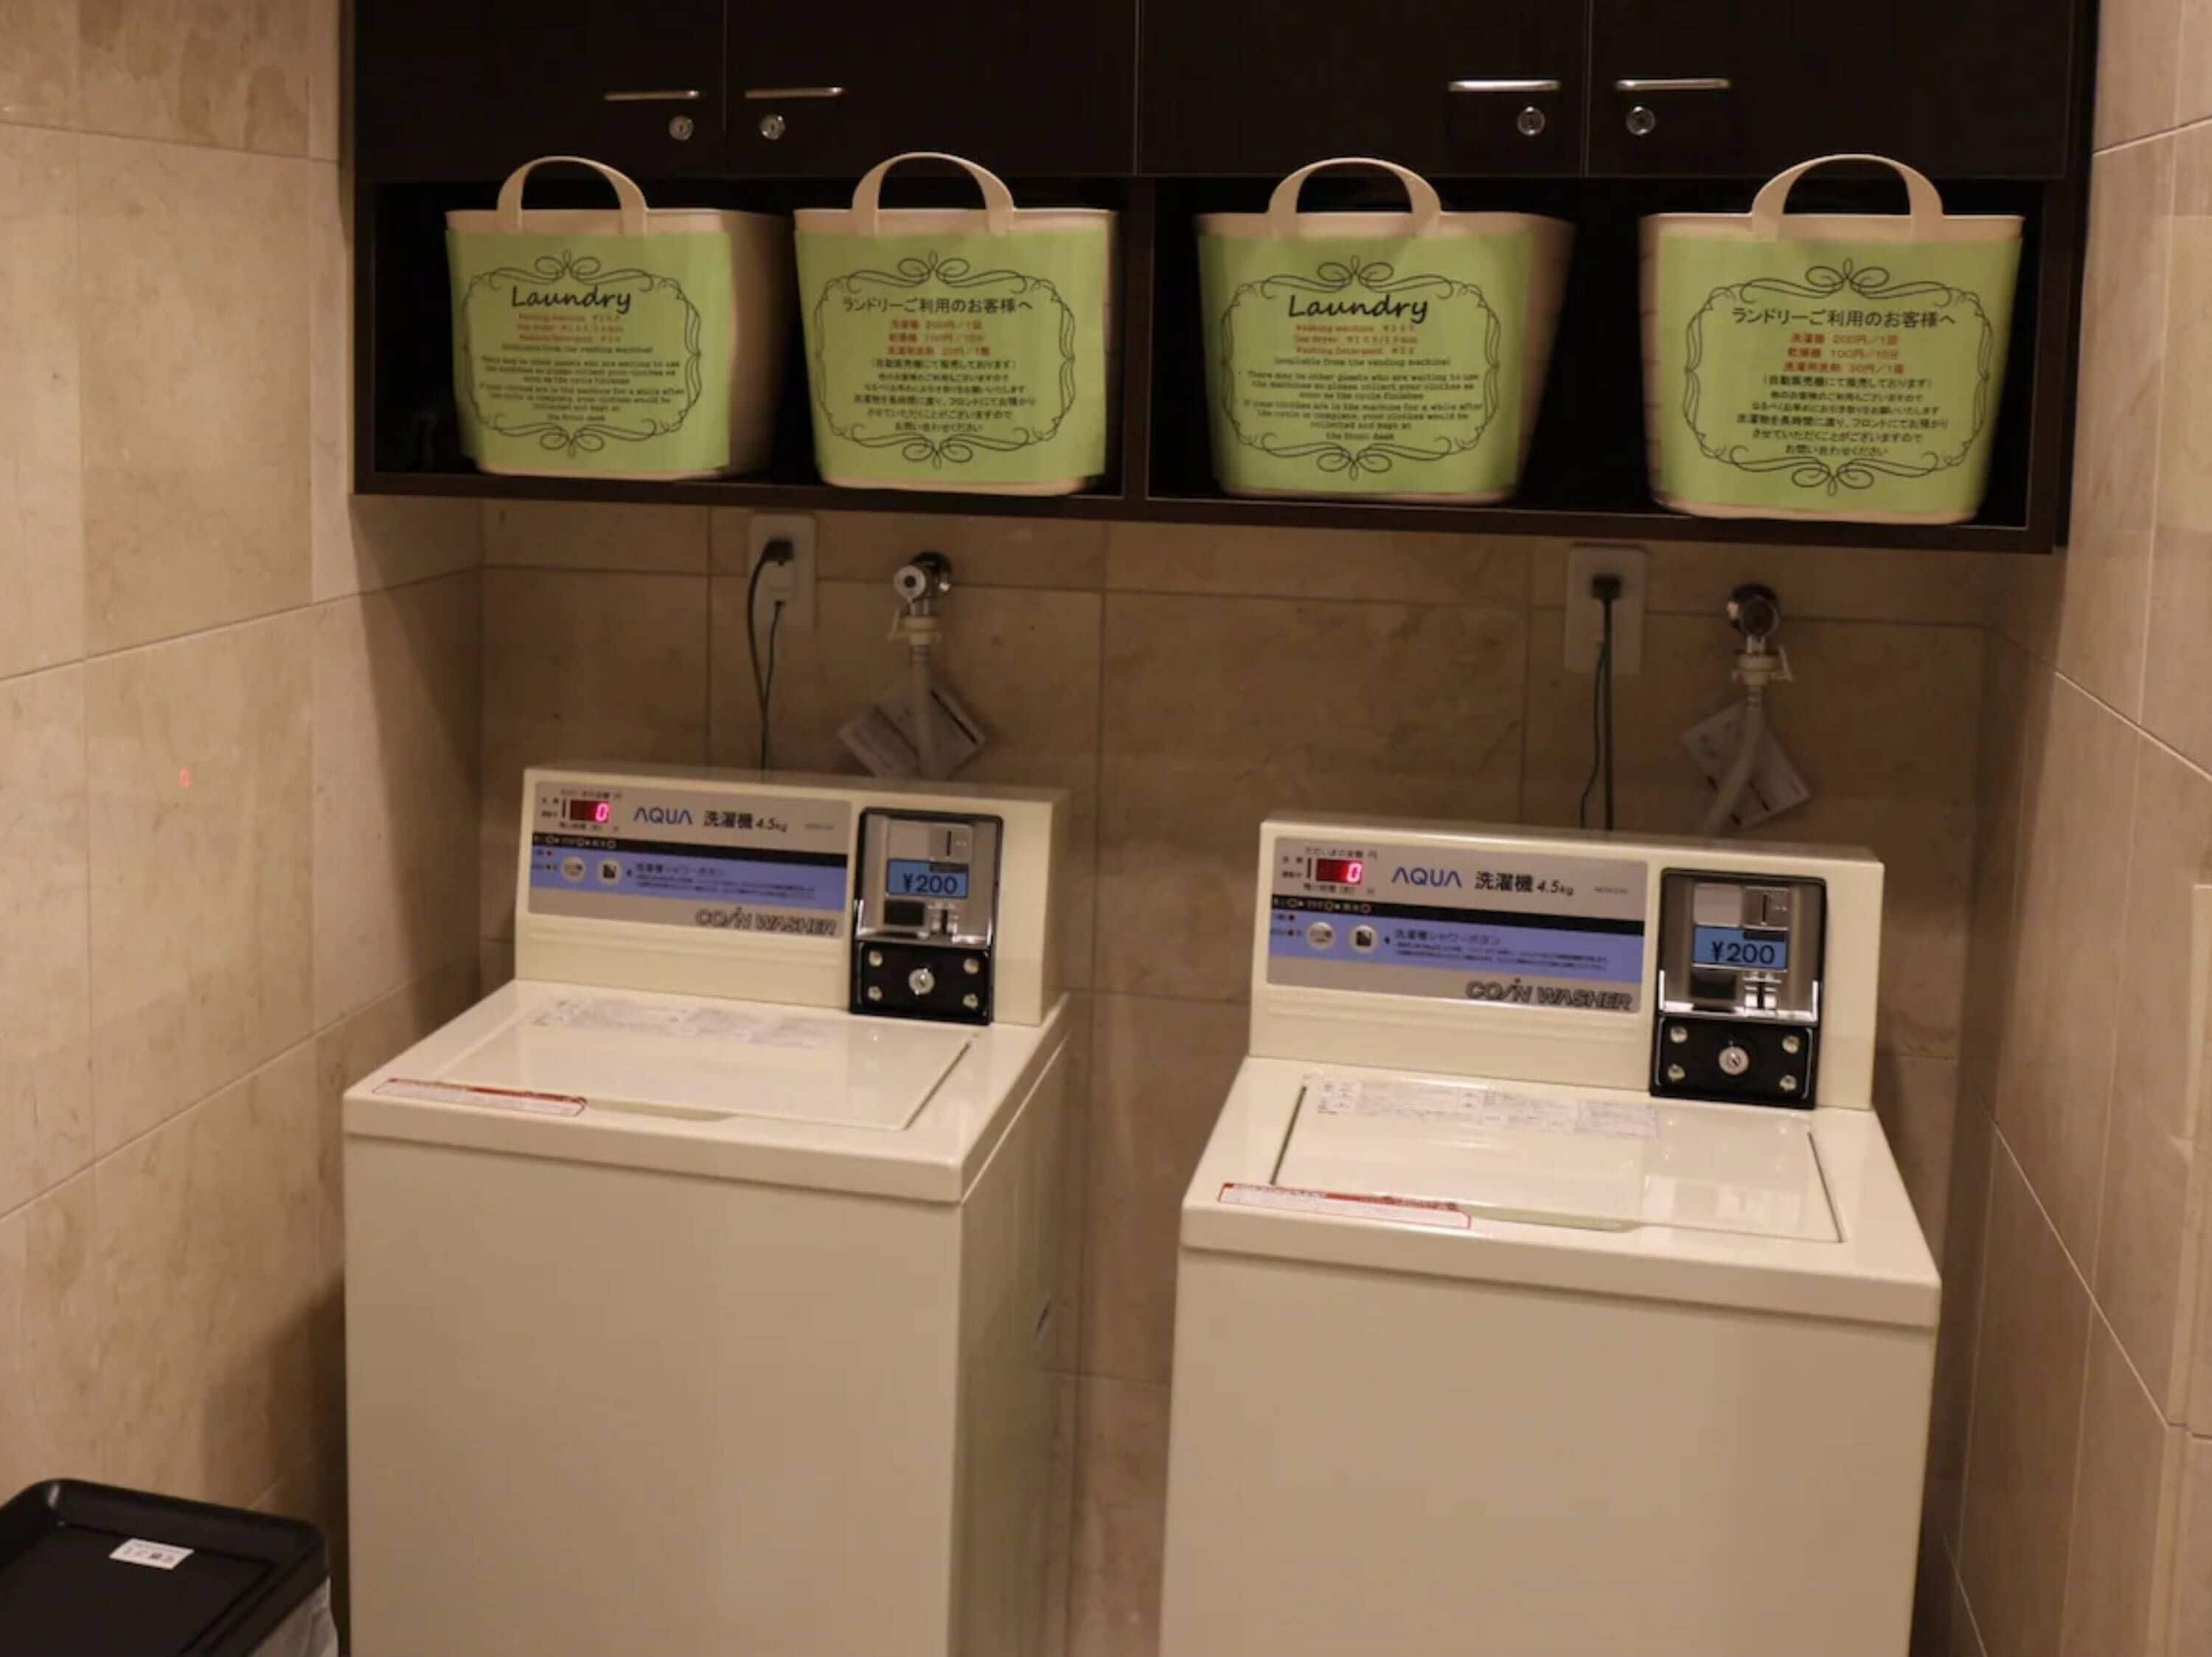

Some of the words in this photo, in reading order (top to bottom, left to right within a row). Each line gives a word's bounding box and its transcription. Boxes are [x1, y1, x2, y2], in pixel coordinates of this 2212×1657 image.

[512, 285, 631, 314] Laundry
[1288, 294, 1428, 324] Laundry
[1733, 307, 1956, 329] ランドリーご利用のお客様へ
[595, 802, 610, 822] 0
[633, 806, 693, 825] AQUA
[902, 872, 958, 894] ¥200
[1347, 862, 1363, 883] 0
[1392, 866, 1463, 889] AQUA
[1475, 870, 1534, 893] 洗濯機
[1537, 878, 1574, 896] 4.5kg
[1711, 940, 1775, 965] ¥200
[1537, 987, 1633, 1011] WASHER
